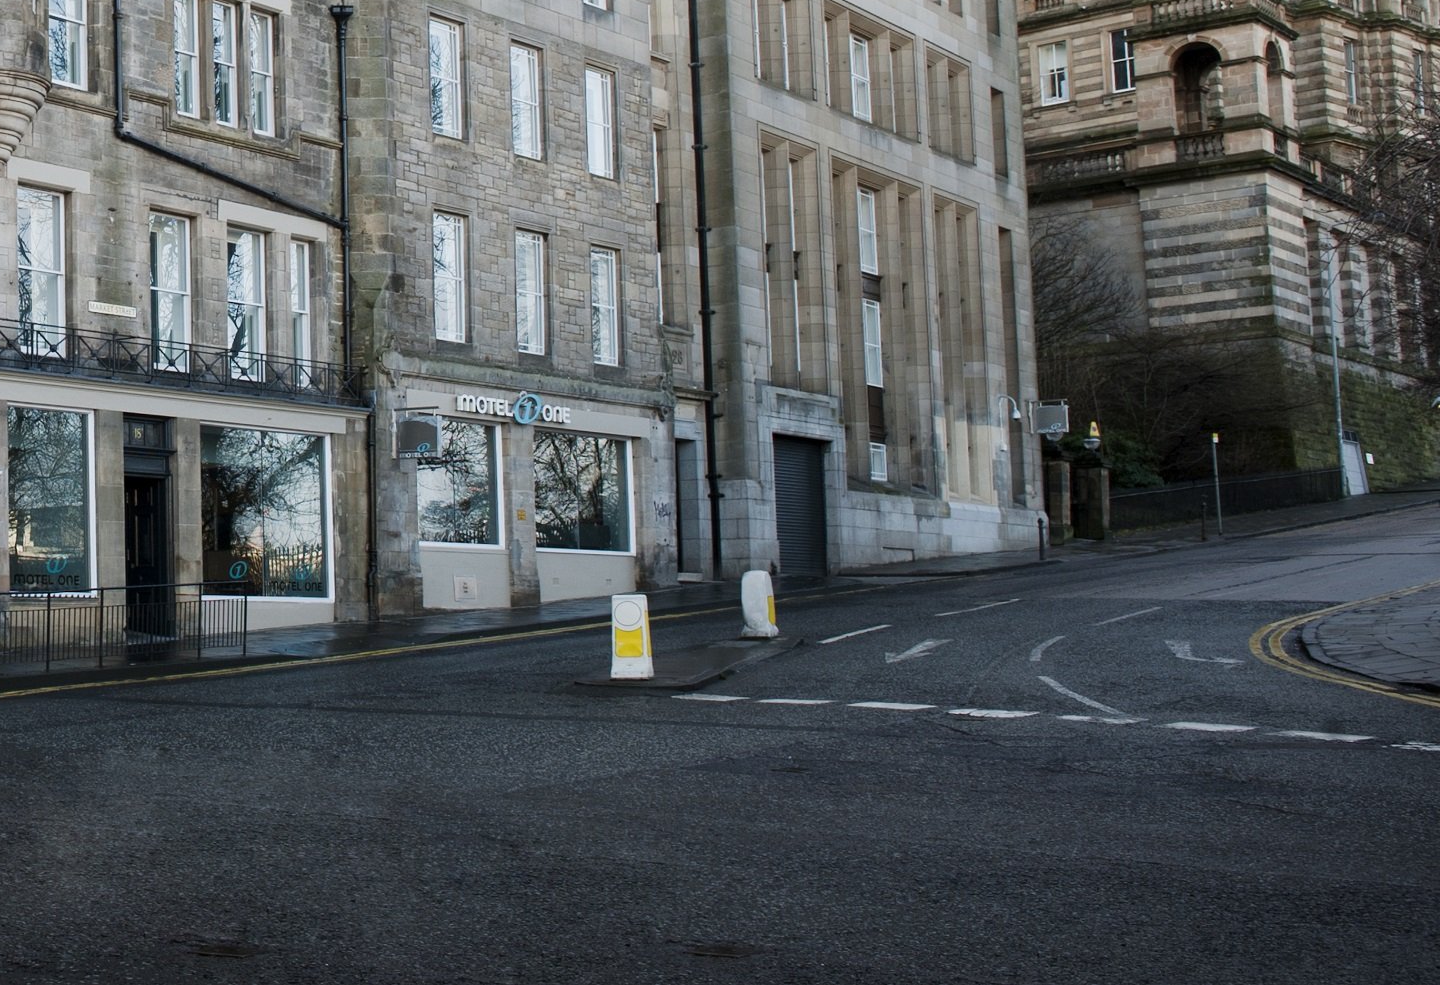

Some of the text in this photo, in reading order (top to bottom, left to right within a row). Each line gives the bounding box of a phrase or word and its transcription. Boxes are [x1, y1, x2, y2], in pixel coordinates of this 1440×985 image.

[89, 302, 135, 316] MARKET STREET
[456, 393, 514, 417] MOTEL
[542, 404, 571, 424] ONE
[14, 574, 80, 586] MOTEL ONE
[304, 581, 322, 592] ONE
